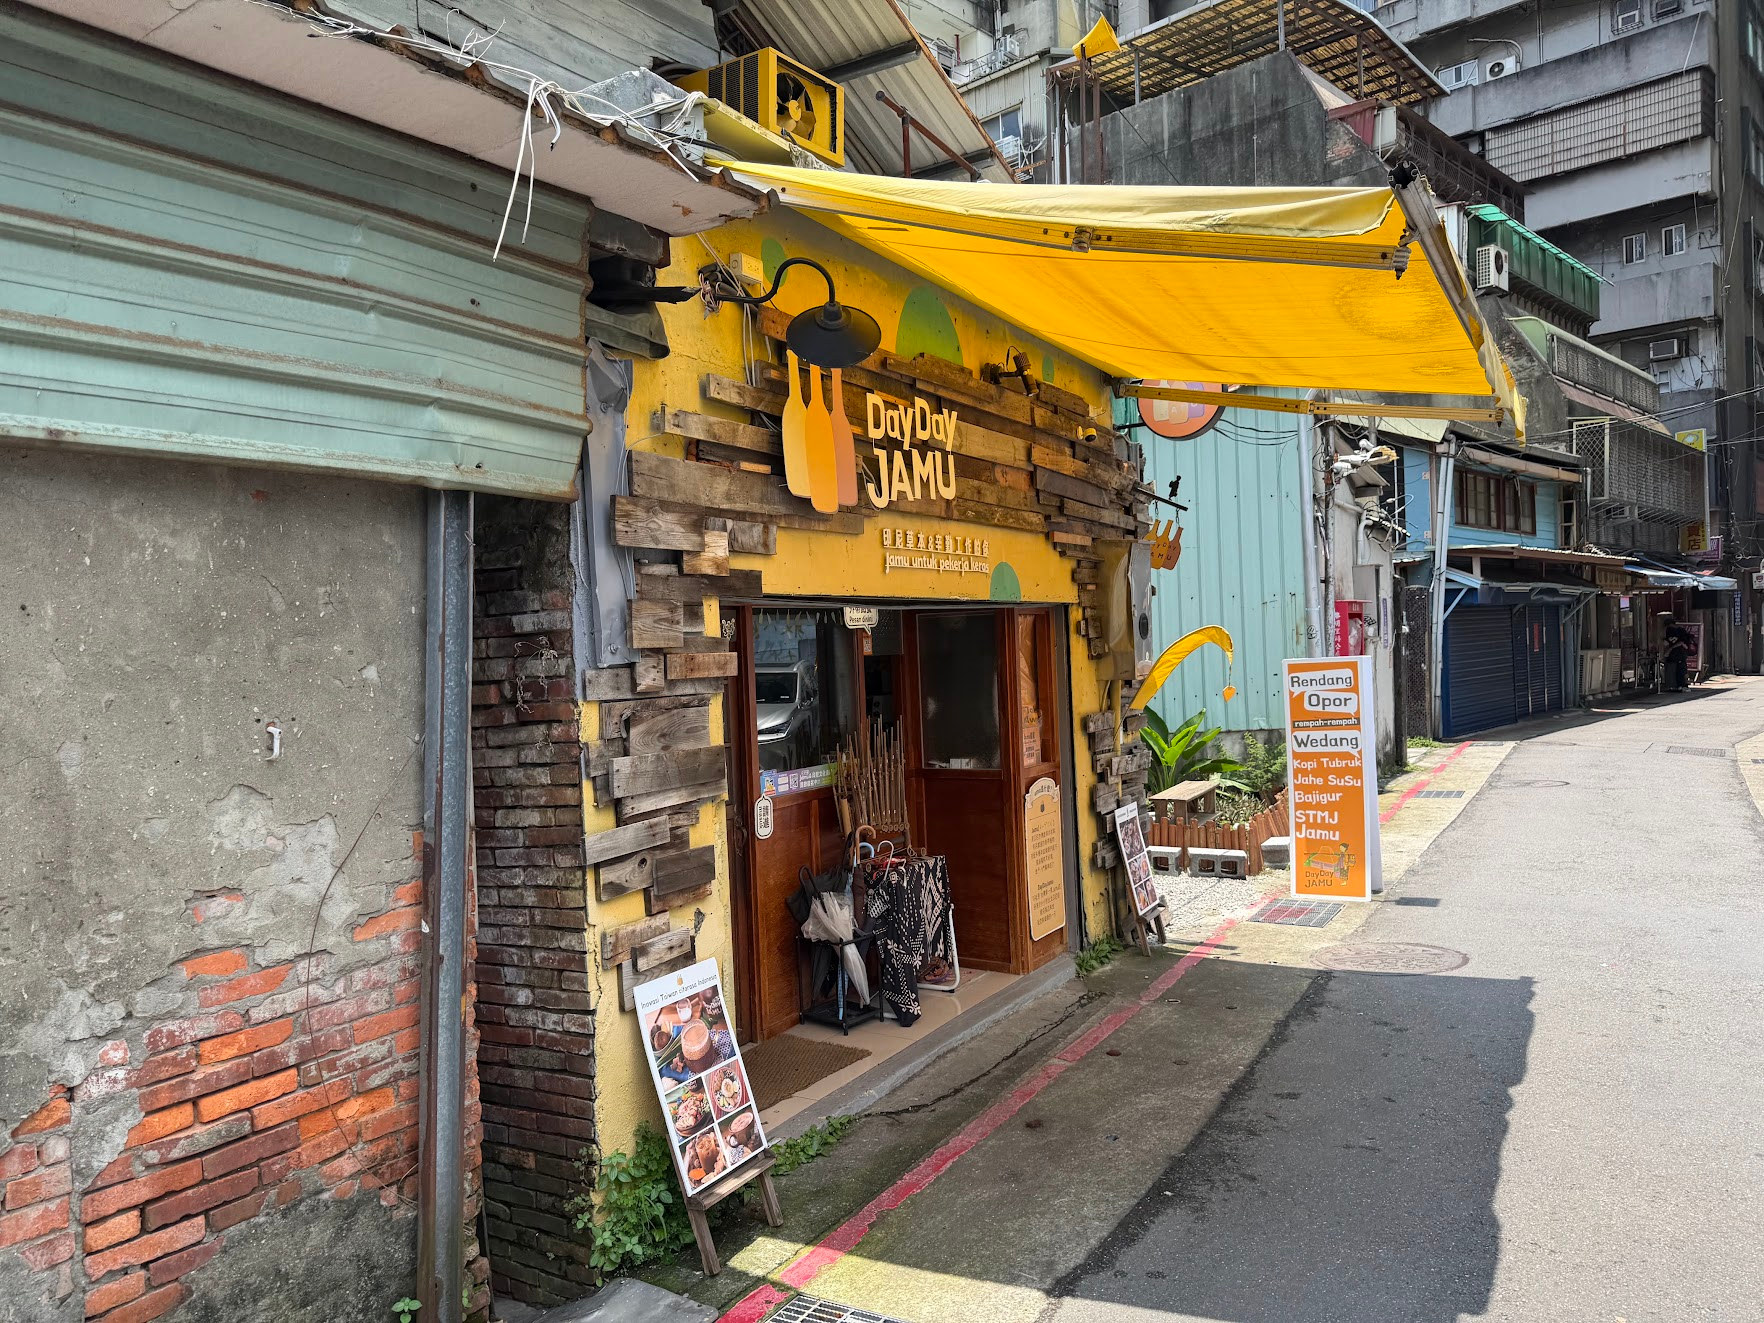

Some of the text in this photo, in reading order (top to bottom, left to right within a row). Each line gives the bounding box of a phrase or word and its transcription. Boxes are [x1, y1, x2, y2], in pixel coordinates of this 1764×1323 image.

[866, 392, 958, 451] DayDay
[867, 447, 957, 509] JAMU
[885, 551, 990, 577] jamu untuk pekerja keras
[1290, 674, 1352, 687] Rendang
[1308, 693, 1352, 710] Opor
[1294, 717, 1358, 728] rempah-rempah
[1293, 733, 1359, 750] Wedang
[1293, 757, 1362, 771] Kopi Tubruk
[1294, 773, 1361, 787] Jahe SuSu
[1294, 790, 1343, 805] Bajigur
[1295, 810, 1339, 824] STMJ
[1296, 823, 1340, 841] Jamu
[1305, 870, 1334, 879] DayDay
[1304, 879, 1333, 888] JAMU
[641, 996, 660, 1009] Inovasi
[660, 990, 678, 1001] Taiwan
